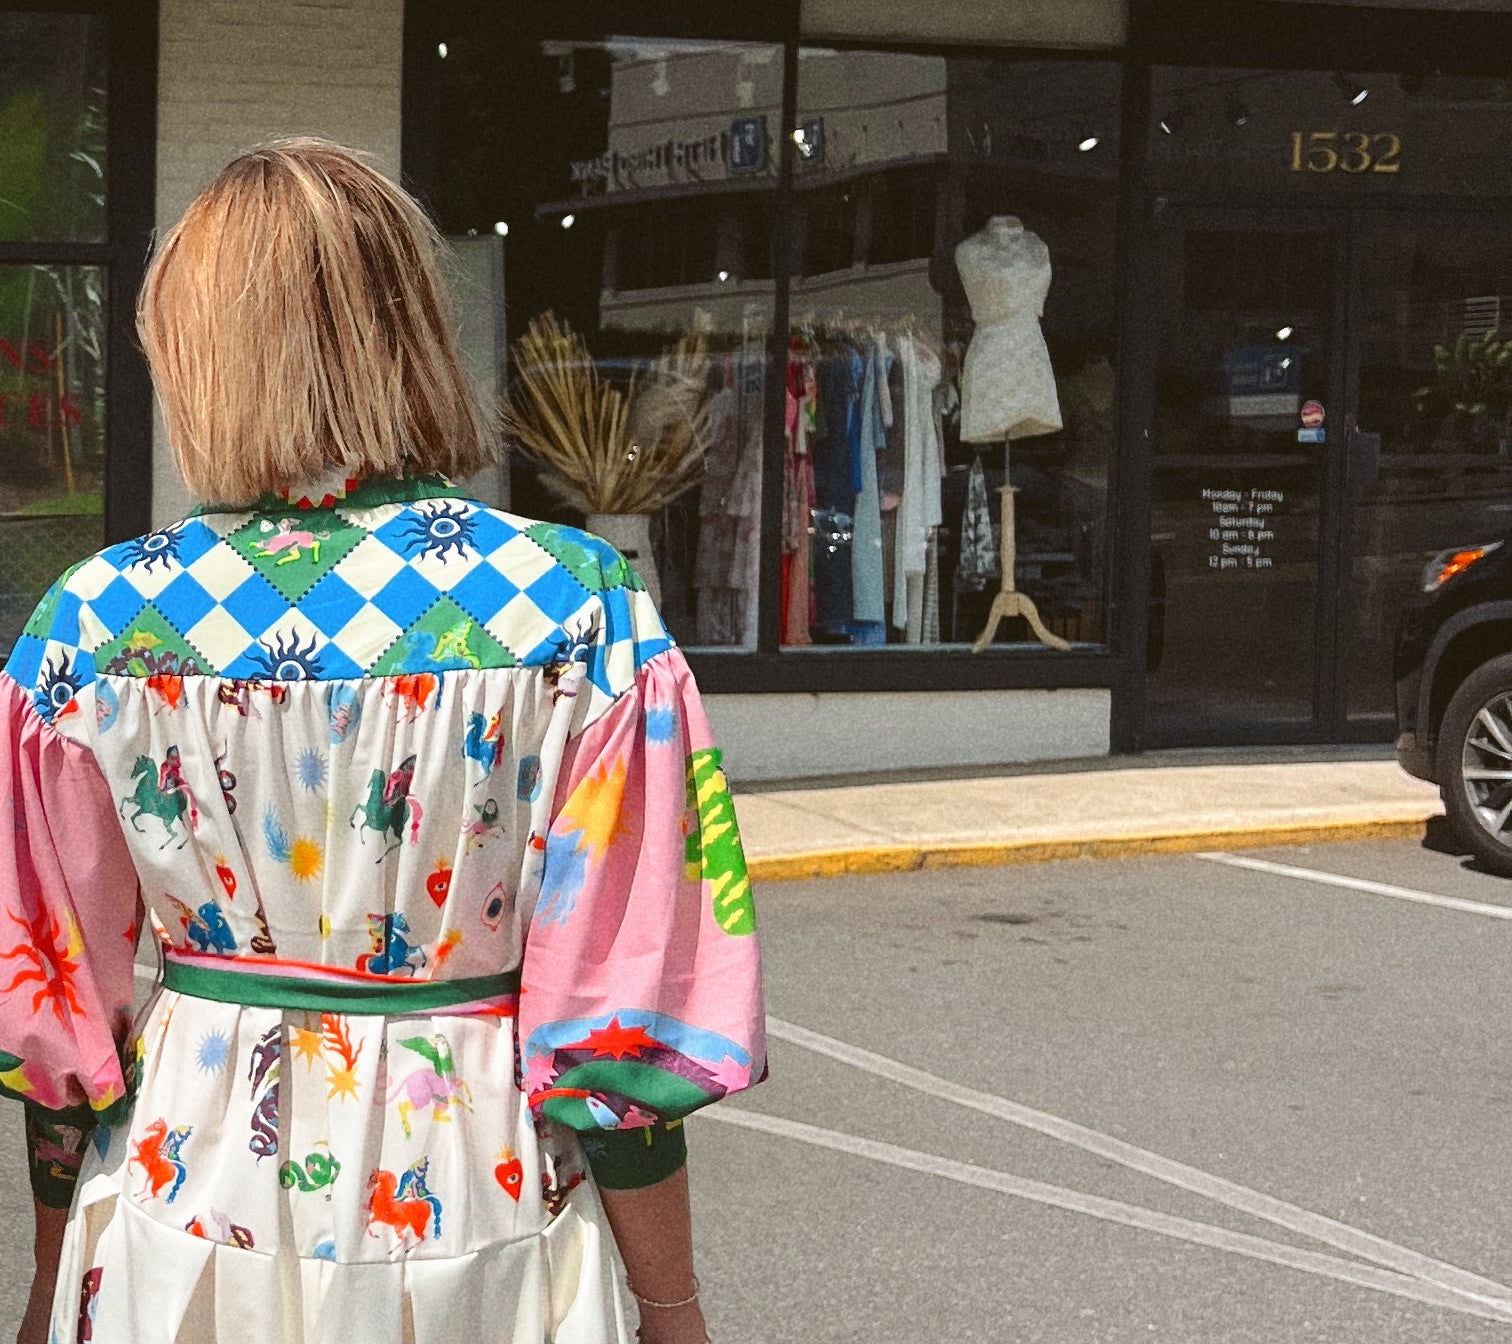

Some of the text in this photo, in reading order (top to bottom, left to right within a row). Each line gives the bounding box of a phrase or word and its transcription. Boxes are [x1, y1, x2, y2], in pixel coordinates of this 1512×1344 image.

[1291, 131, 1401, 173] 1532
[1202, 488, 1241, 502] Monday
[1251, 488, 1283, 502] Friday
[1219, 515, 1265, 529] Saturday
[1222, 542, 1259, 556] Sunday
